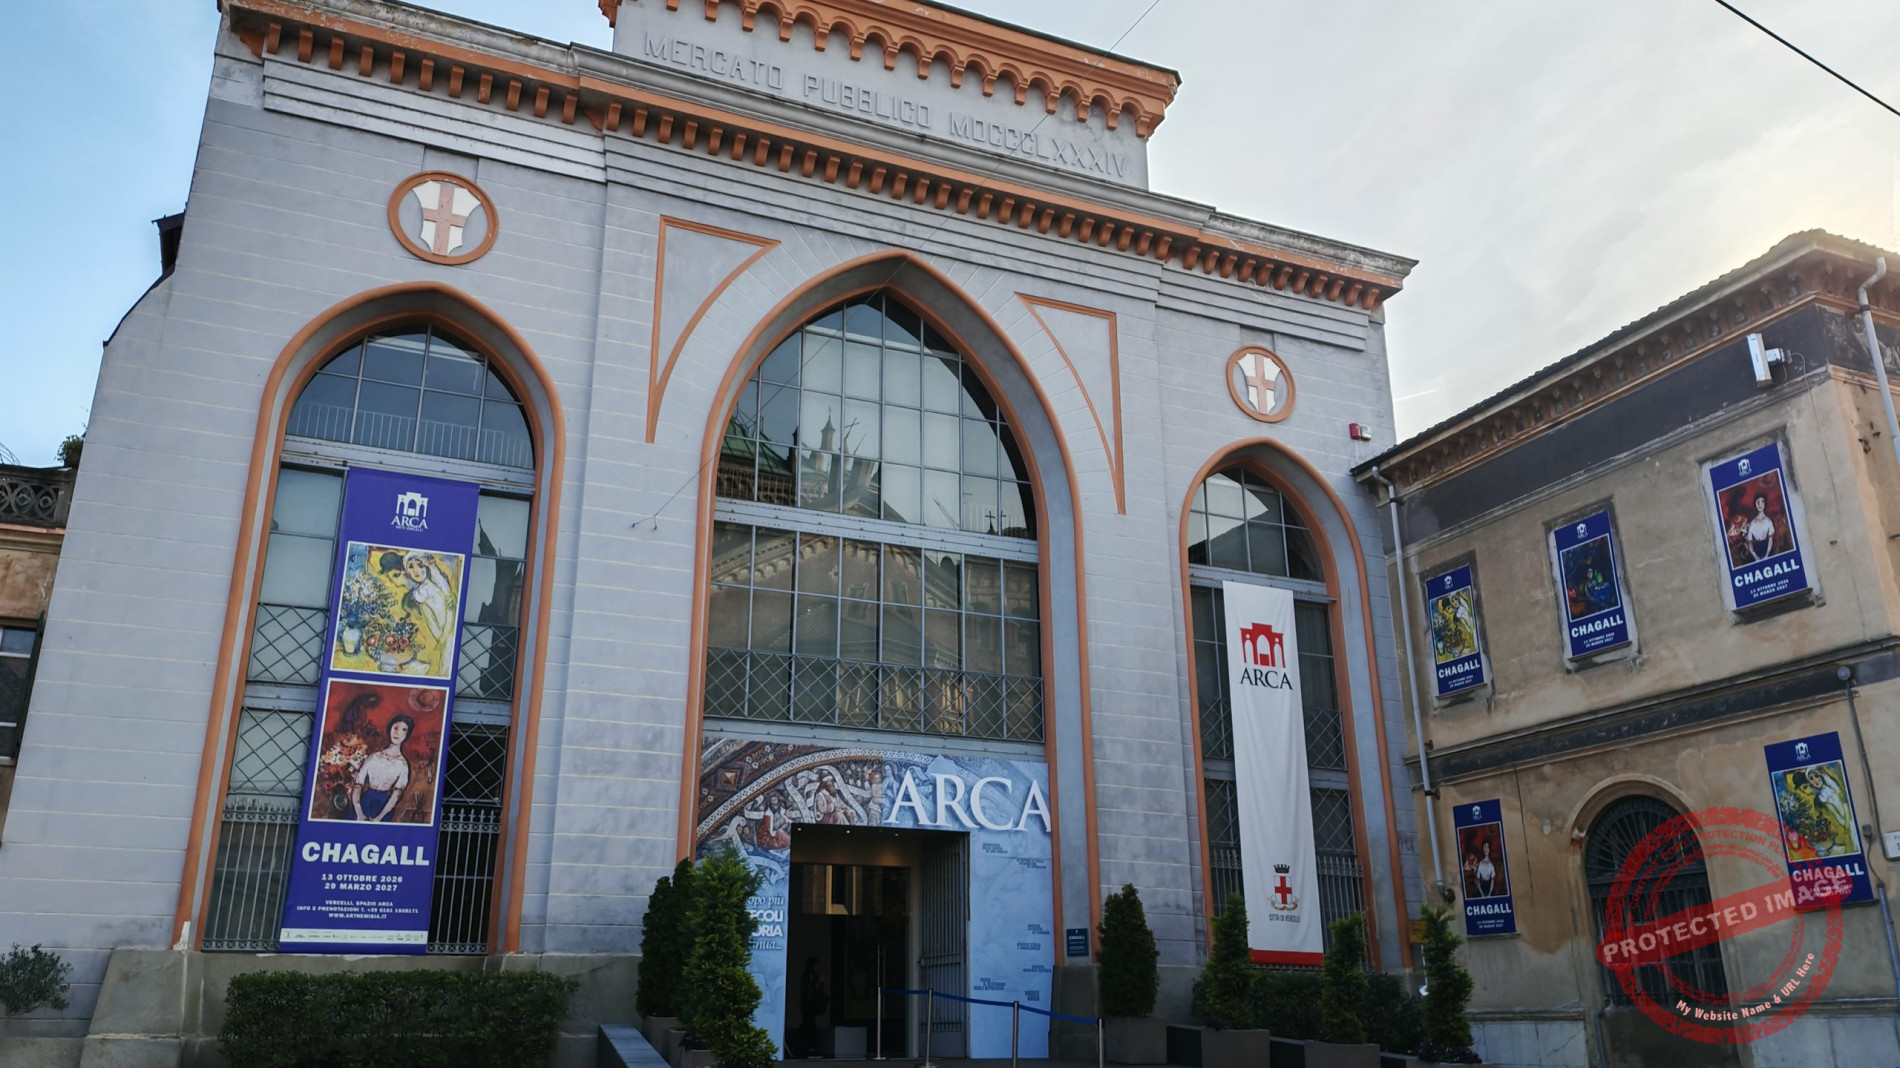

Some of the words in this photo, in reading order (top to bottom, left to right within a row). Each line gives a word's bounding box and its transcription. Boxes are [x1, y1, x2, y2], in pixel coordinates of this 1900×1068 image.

[644, 32, 784, 90] MERCATO
[803, 73, 931, 129] PUBBLICO
[949, 111, 1128, 178] MDCCCLXXXIV
[391, 515, 428, 529] ARCA
[1734, 558, 1800, 587] CHAGALL
[1571, 614, 1623, 638] CHAGALL
[1240, 667, 1293, 690] ARCA
[1438, 659, 1480, 679] CHAGALL
[883, 769, 1052, 833] ARCA
[301, 841, 430, 866] CHAGALL
[321, 873, 333, 881] 13
[336, 874, 378, 882] OTTOBRE
[380, 875, 403, 883] 2026
[1792, 863, 1864, 882] CHAGALL
[339, 883, 372, 891] MARZO
[1466, 903, 1512, 916] CHAGALL
